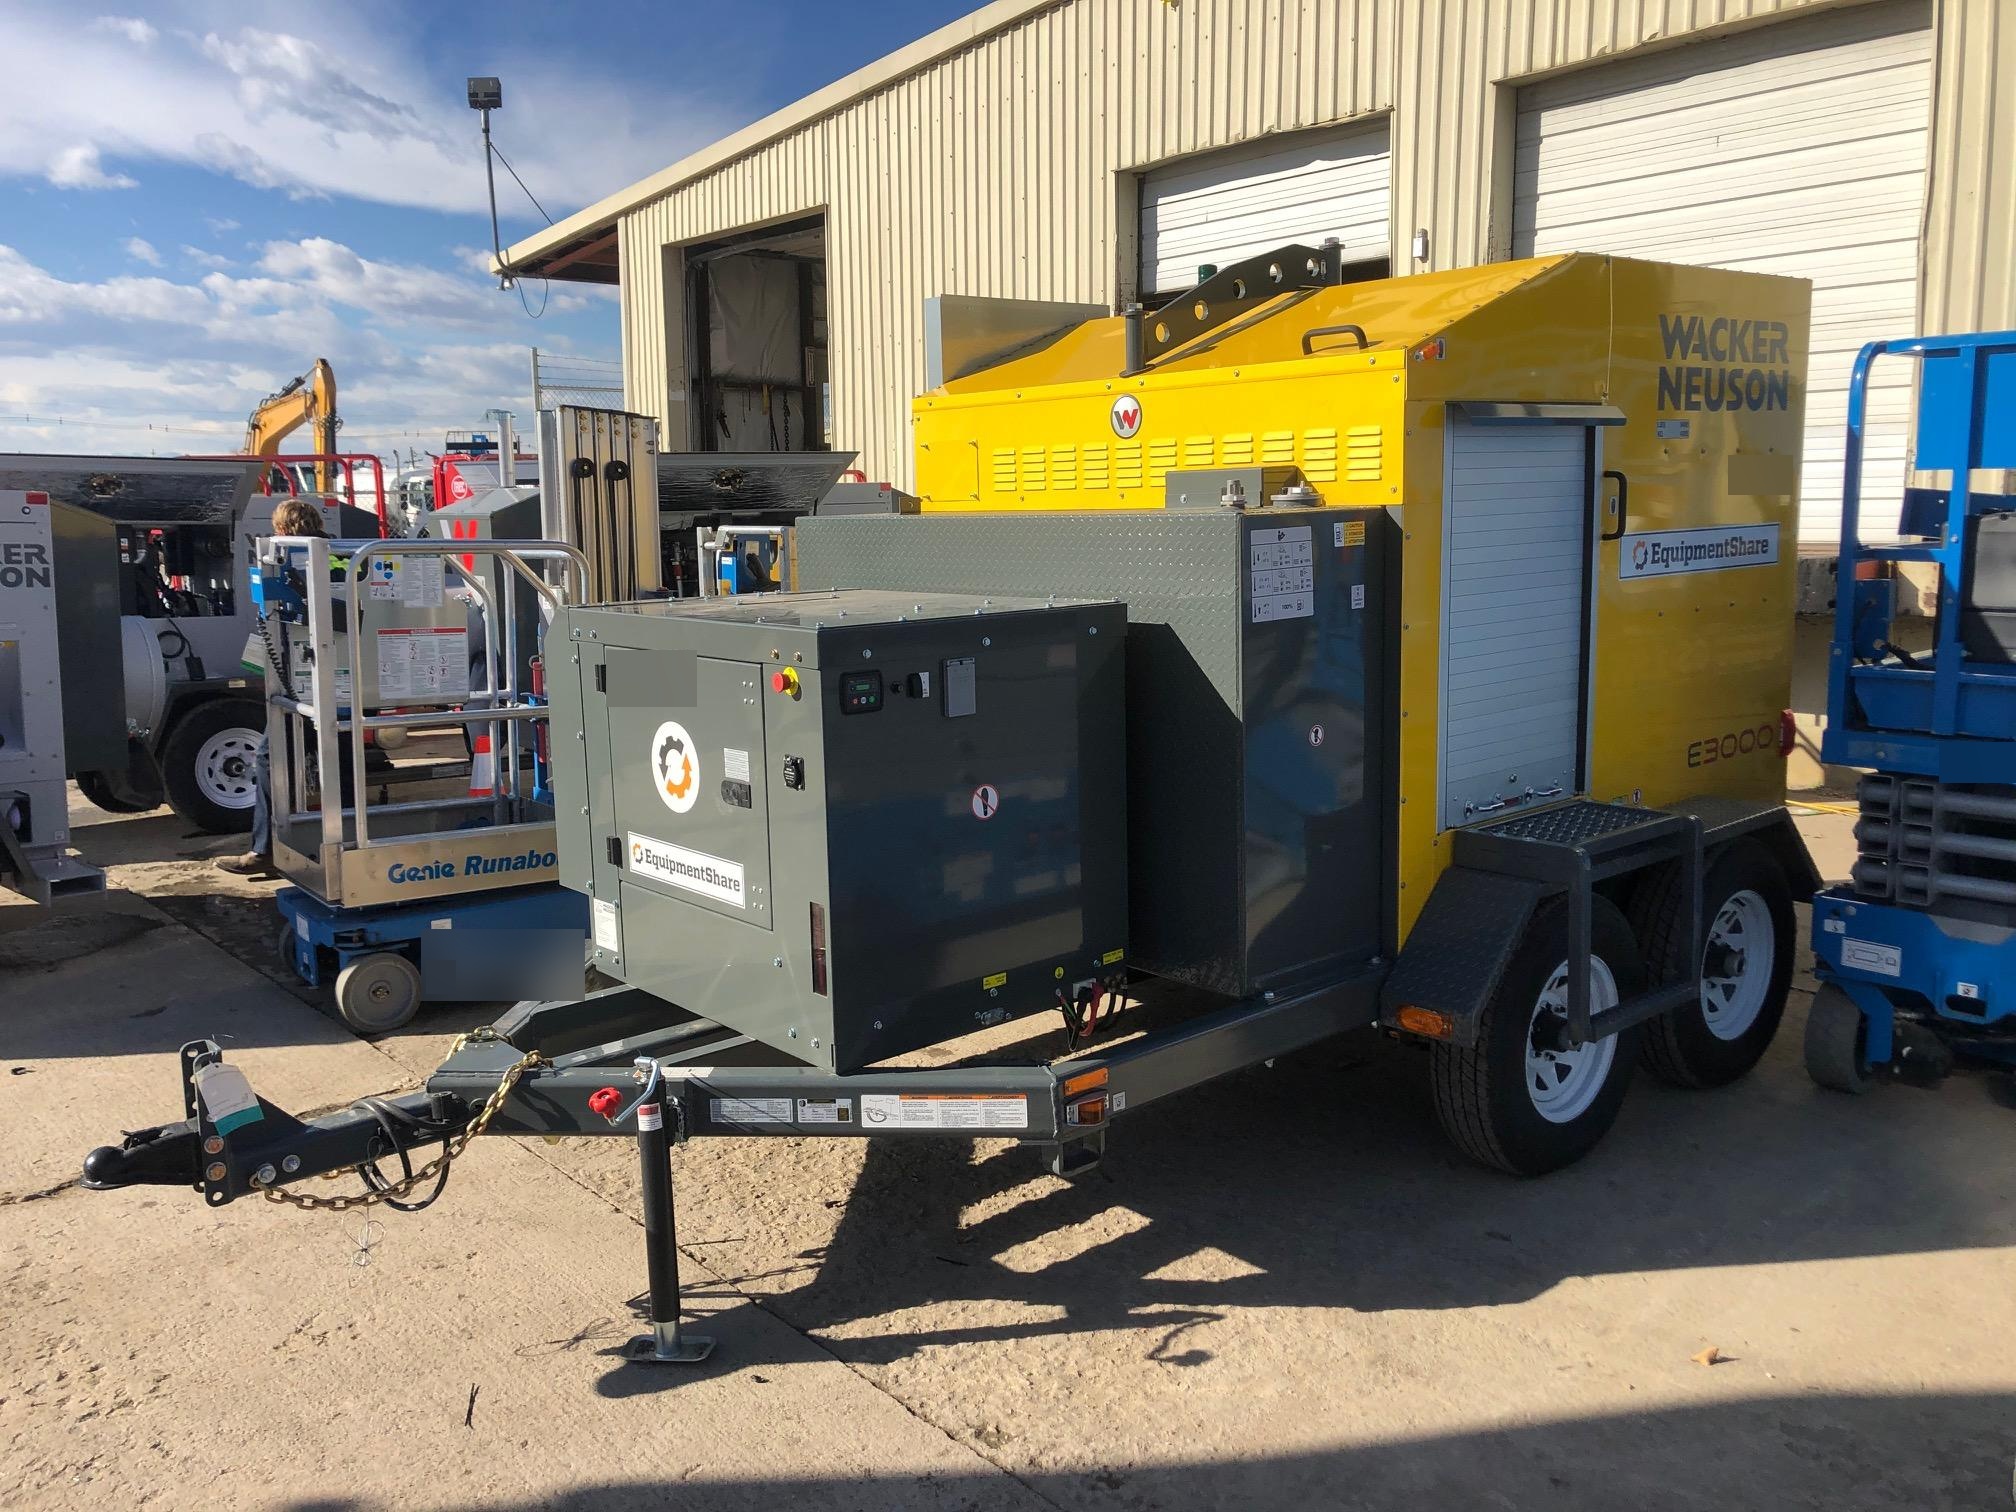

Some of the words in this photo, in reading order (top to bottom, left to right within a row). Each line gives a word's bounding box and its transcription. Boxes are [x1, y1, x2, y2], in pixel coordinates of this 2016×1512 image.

[1659, 314, 1789, 364] WACKER
[1657, 366, 1789, 412] NEUSON
[1114, 409, 1138, 430] W
[0, 543, 49, 565] ER
[1651, 536, 1769, 568] EquipmentShare
[1687, 724, 1774, 768] E3000
[388, 859, 456, 884] Genie
[464, 849, 559, 876] Runabo
[644, 848, 741, 892] EquipmentShare
